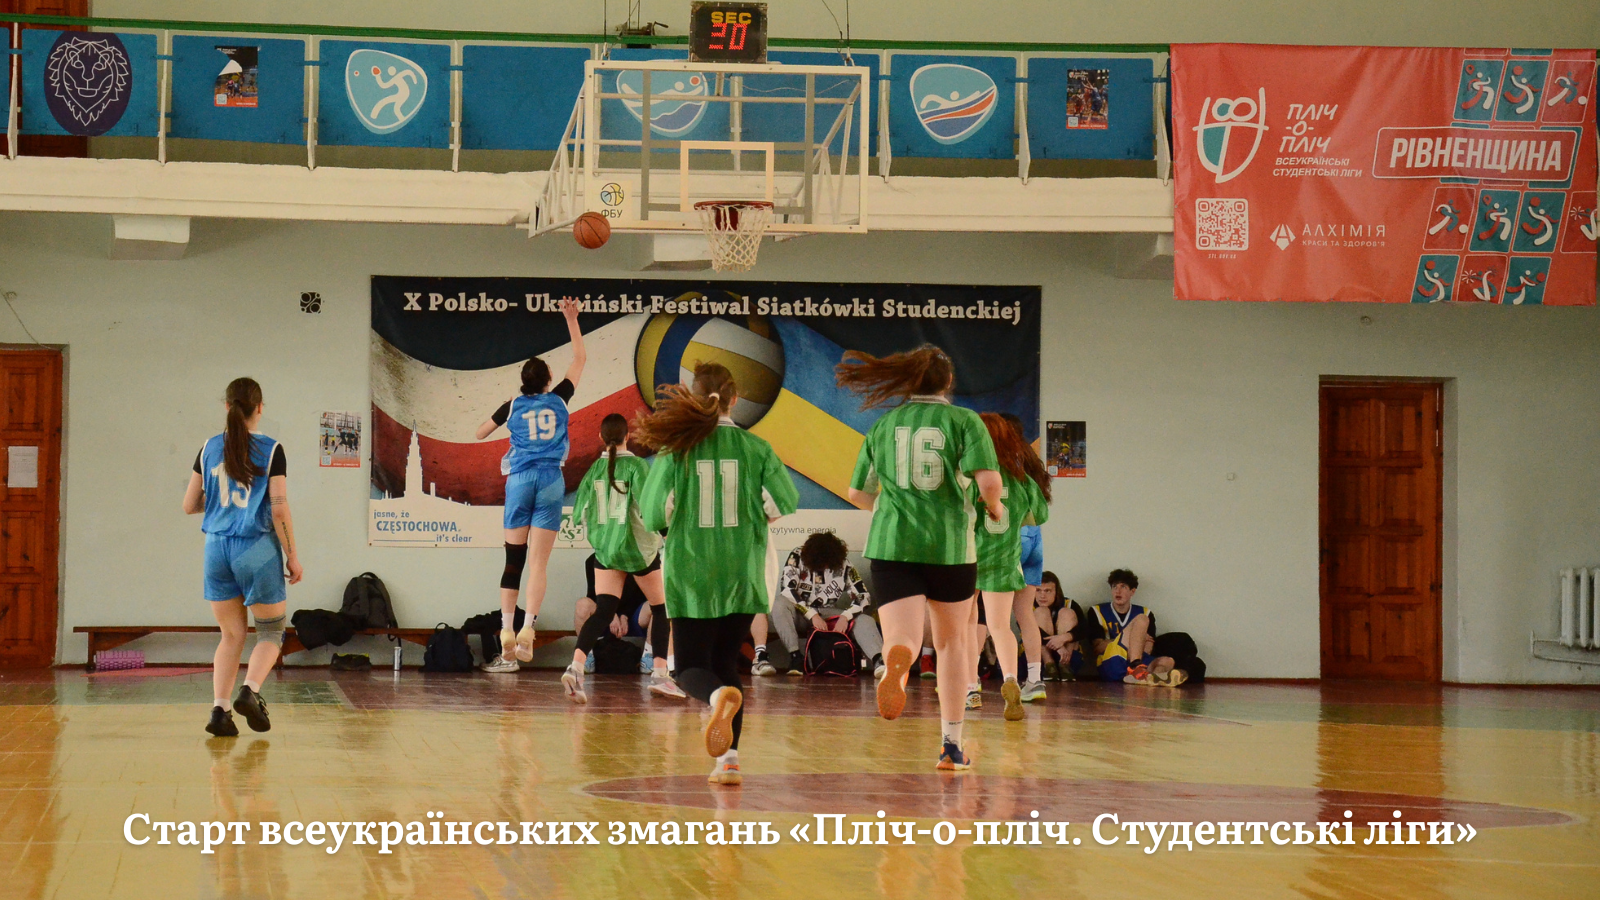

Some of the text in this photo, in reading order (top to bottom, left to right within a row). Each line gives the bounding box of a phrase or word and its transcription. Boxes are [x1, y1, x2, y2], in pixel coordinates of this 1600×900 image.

[711, 11, 752, 24] SEC
[1287, 103, 1339, 120] ПЛІЧ
[1279, 136, 1332, 153] ПЛІЧ
[1275, 156, 1350, 166] ВСЕУКРАЇНСЬКІ
[1389, 137, 1562, 173] РІВНЕНЩИНА
[1272, 168, 1363, 178] СТУДЕНТСЬКІ ЛІГИ
[1302, 223, 1386, 237] АЛХІМІЯ
[403, 292, 1021, 325] X Polsko- Ukiński Festiwal Siatkówki Studenckiej
[521, 408, 557, 441] 19
[894, 426, 946, 491] 16
[594, 479, 627, 525] 14
[696, 459, 739, 528] 11
[373, 509, 410, 519] jasne, że
[436, 533, 473, 543] it's clear
